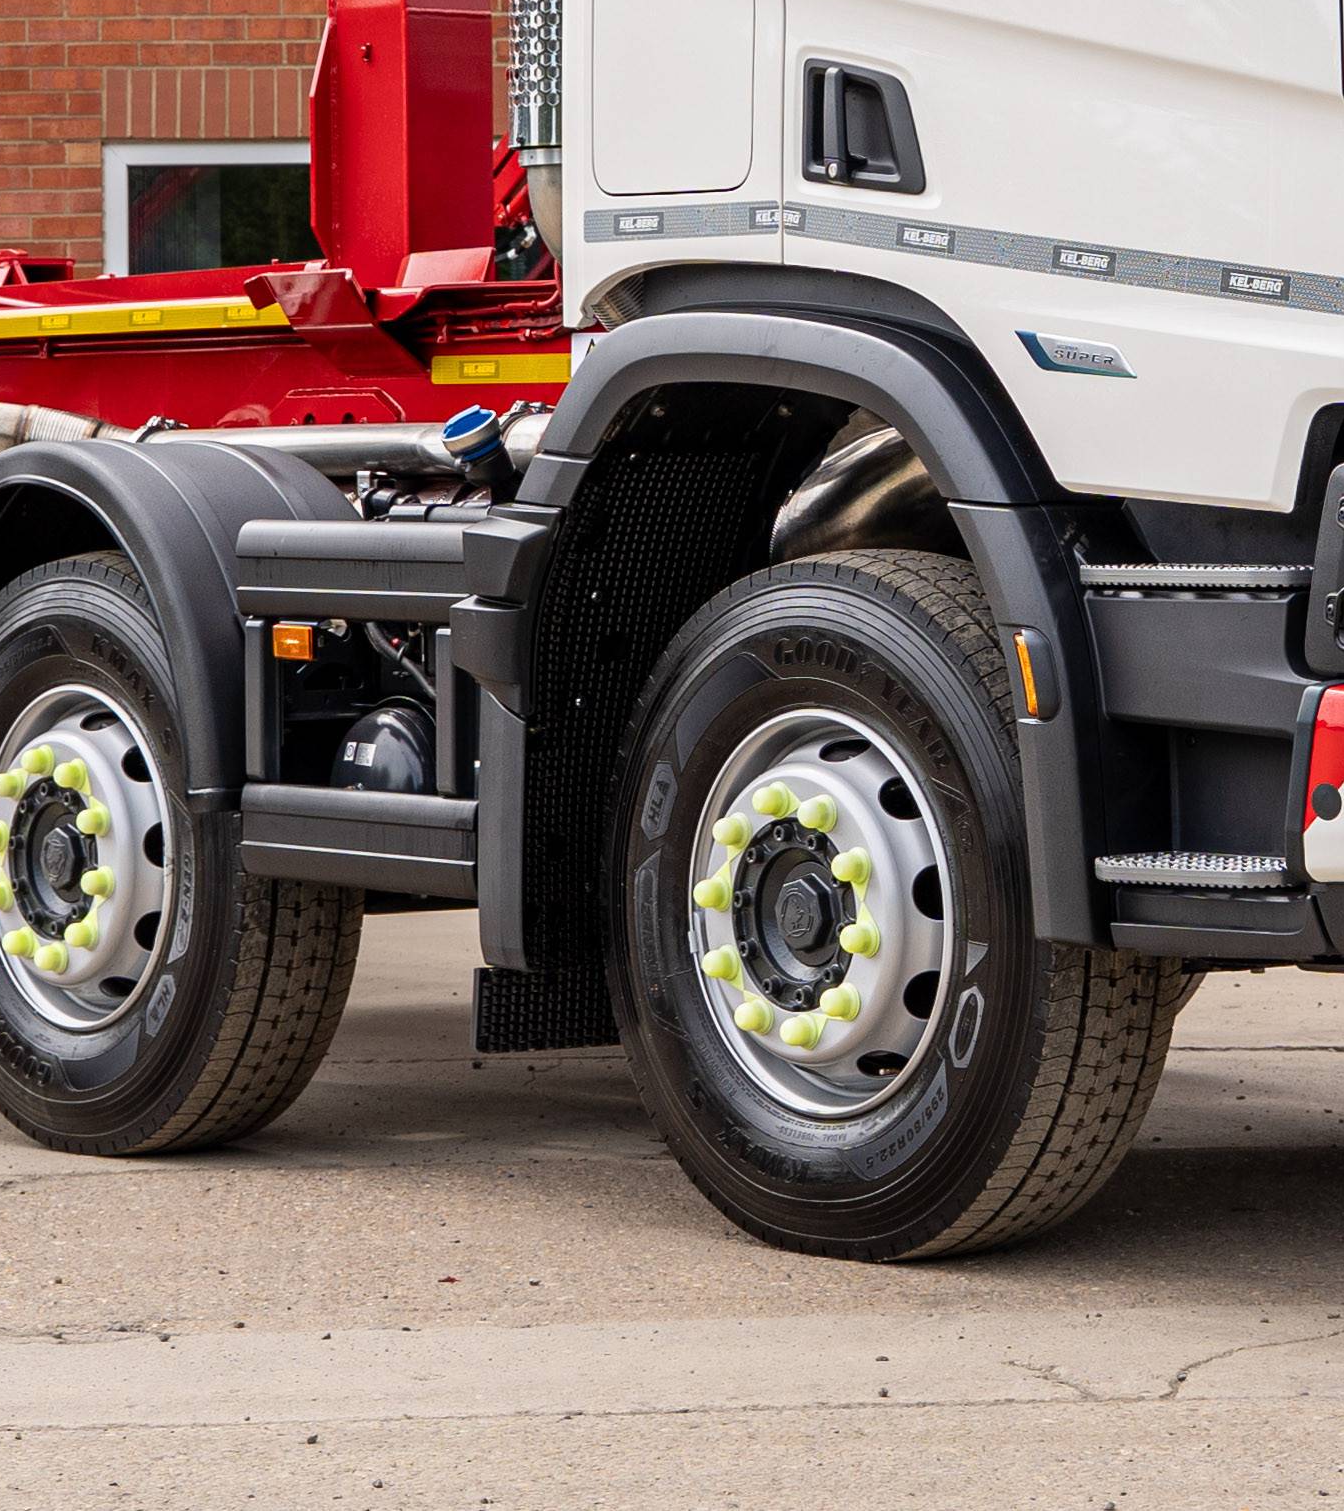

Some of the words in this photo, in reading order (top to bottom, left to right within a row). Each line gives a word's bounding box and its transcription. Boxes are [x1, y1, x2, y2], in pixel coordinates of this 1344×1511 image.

[618, 215, 660, 230] KEL-BERG
[902, 228, 950, 246] KEL-BERG
[1059, 250, 1110, 269] KEL-BERG
[1228, 273, 1284, 293] KEL-BERG
[1053, 349, 1115, 365] SUPER
[90, 632, 156, 711] KMAX
[865, 1086, 946, 1170] 295/80R22.5
